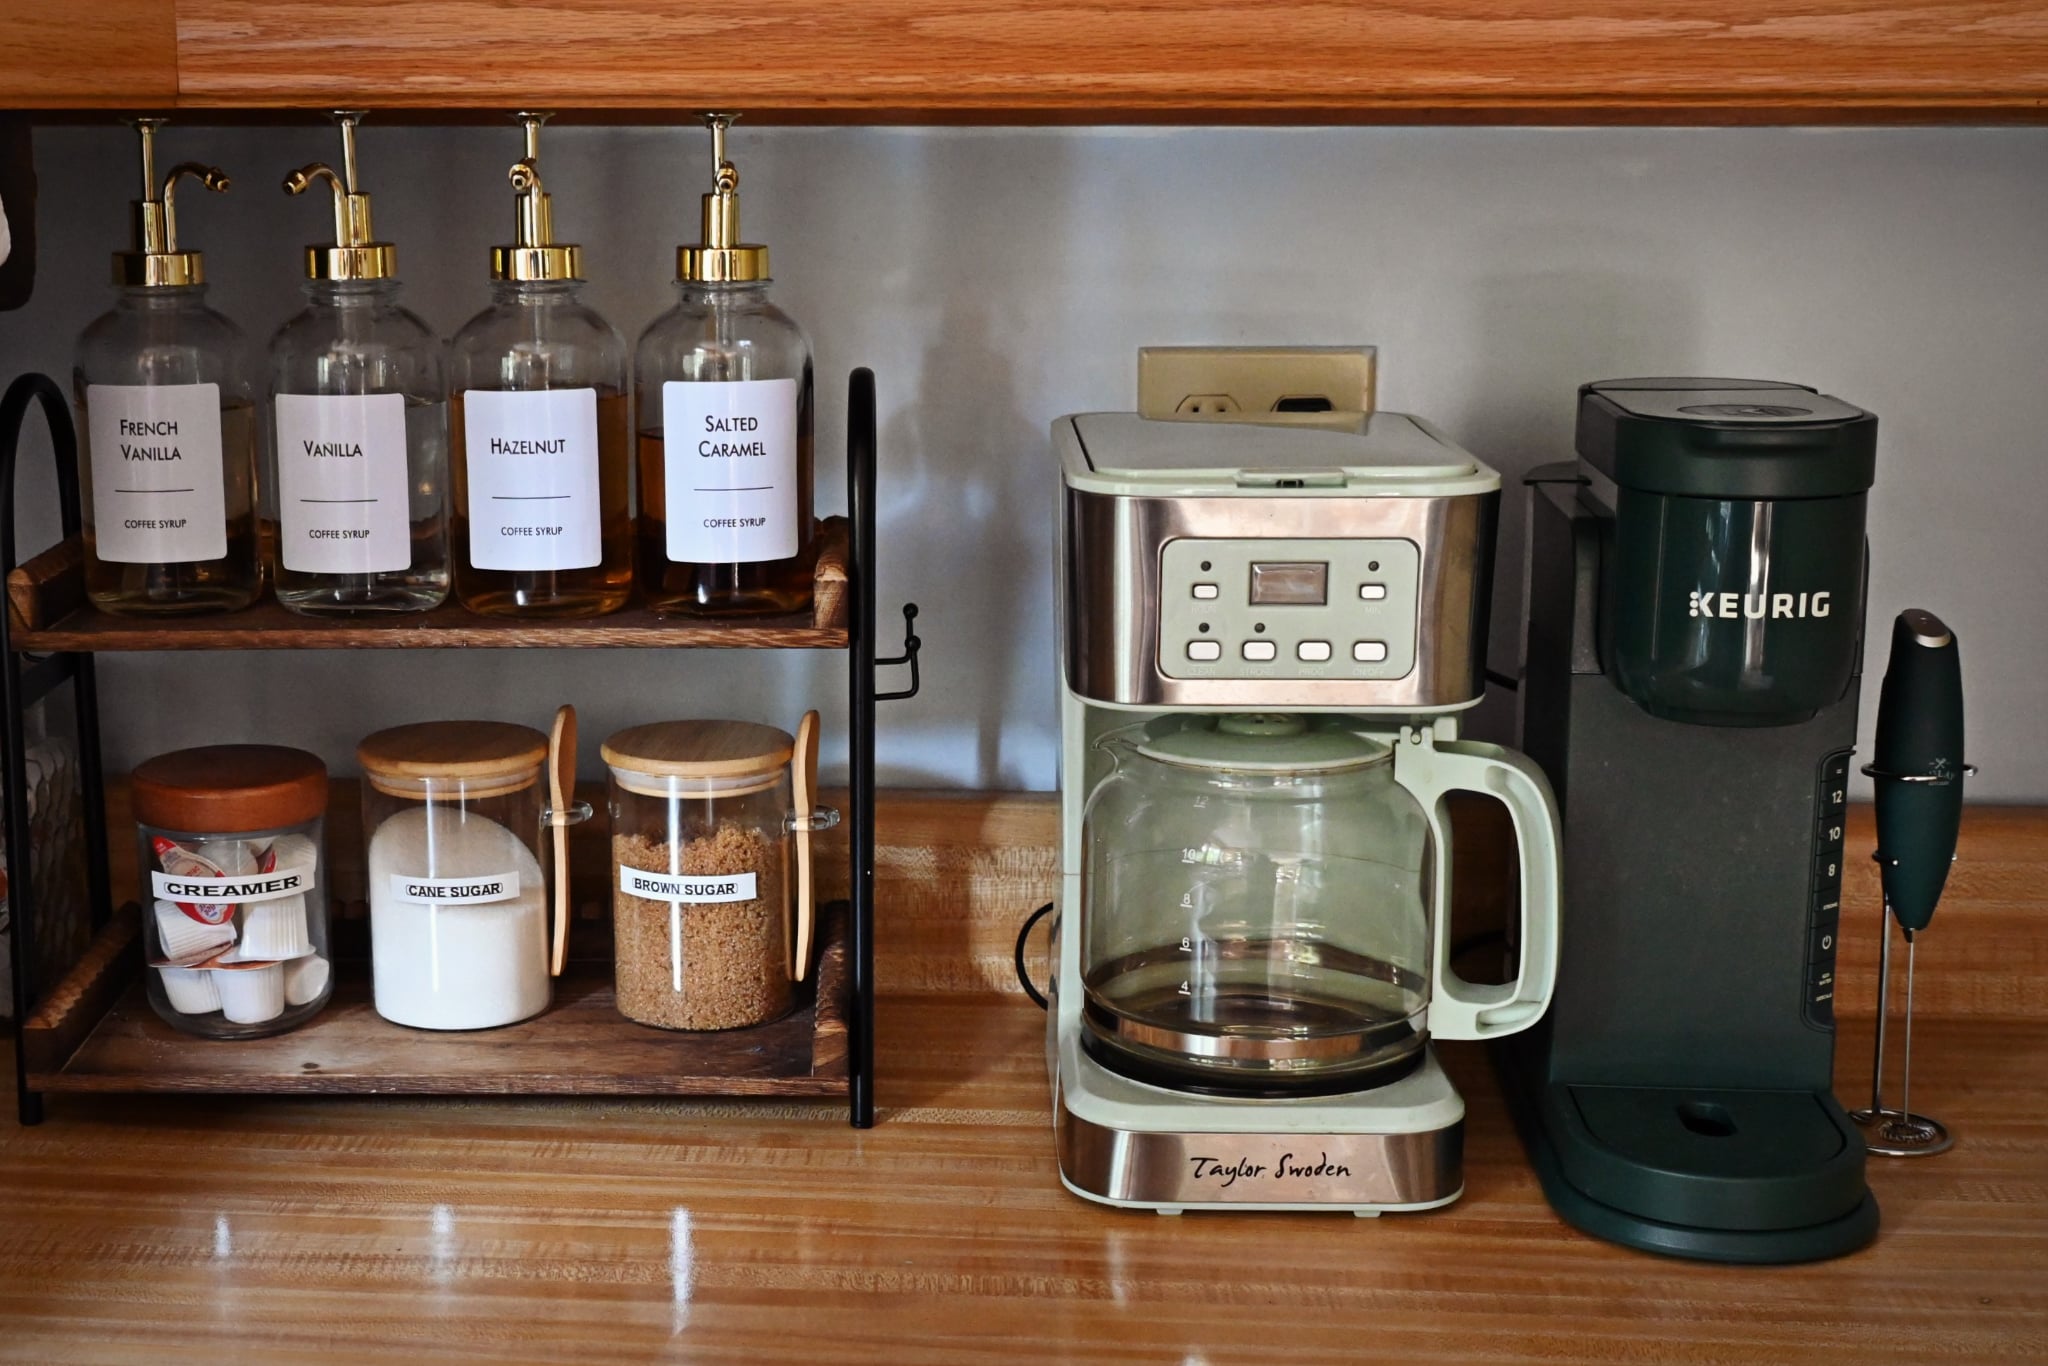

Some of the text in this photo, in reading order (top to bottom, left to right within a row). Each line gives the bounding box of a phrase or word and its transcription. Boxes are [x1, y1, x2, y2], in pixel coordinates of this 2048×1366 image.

[119, 418, 179, 437] FRENCH
[704, 415, 759, 433] SALTED
[120, 444, 182, 461] VANILLA
[303, 440, 363, 458] VANILLA
[490, 438, 567, 455] HAZELNUT
[698, 440, 767, 458] CARAMEL
[124, 518, 187, 530] COFFEE SYRUP
[703, 516, 767, 529] COFFEE SYRUP
[308, 528, 370, 540] COFFEE SYRUP
[501, 525, 564, 537] COFFEE SYRUP
[1688, 590, 1832, 620] KEURIG
[1831, 790, 1843, 805] 12
[1828, 826, 1842, 842] 10
[1182, 847, 1196, 860] 10
[1827, 863, 1836, 878] 8
[167, 875, 300, 898] CREAMER
[408, 881, 503, 898] CANE SUGAR
[634, 877, 736, 897] BROWN SUGAR
[1183, 893, 1191, 905] 8
[1182, 937, 1190, 949] 6
[1181, 980, 1189, 992] 4
[1190, 1151, 1352, 1188] Taylor Swoden
